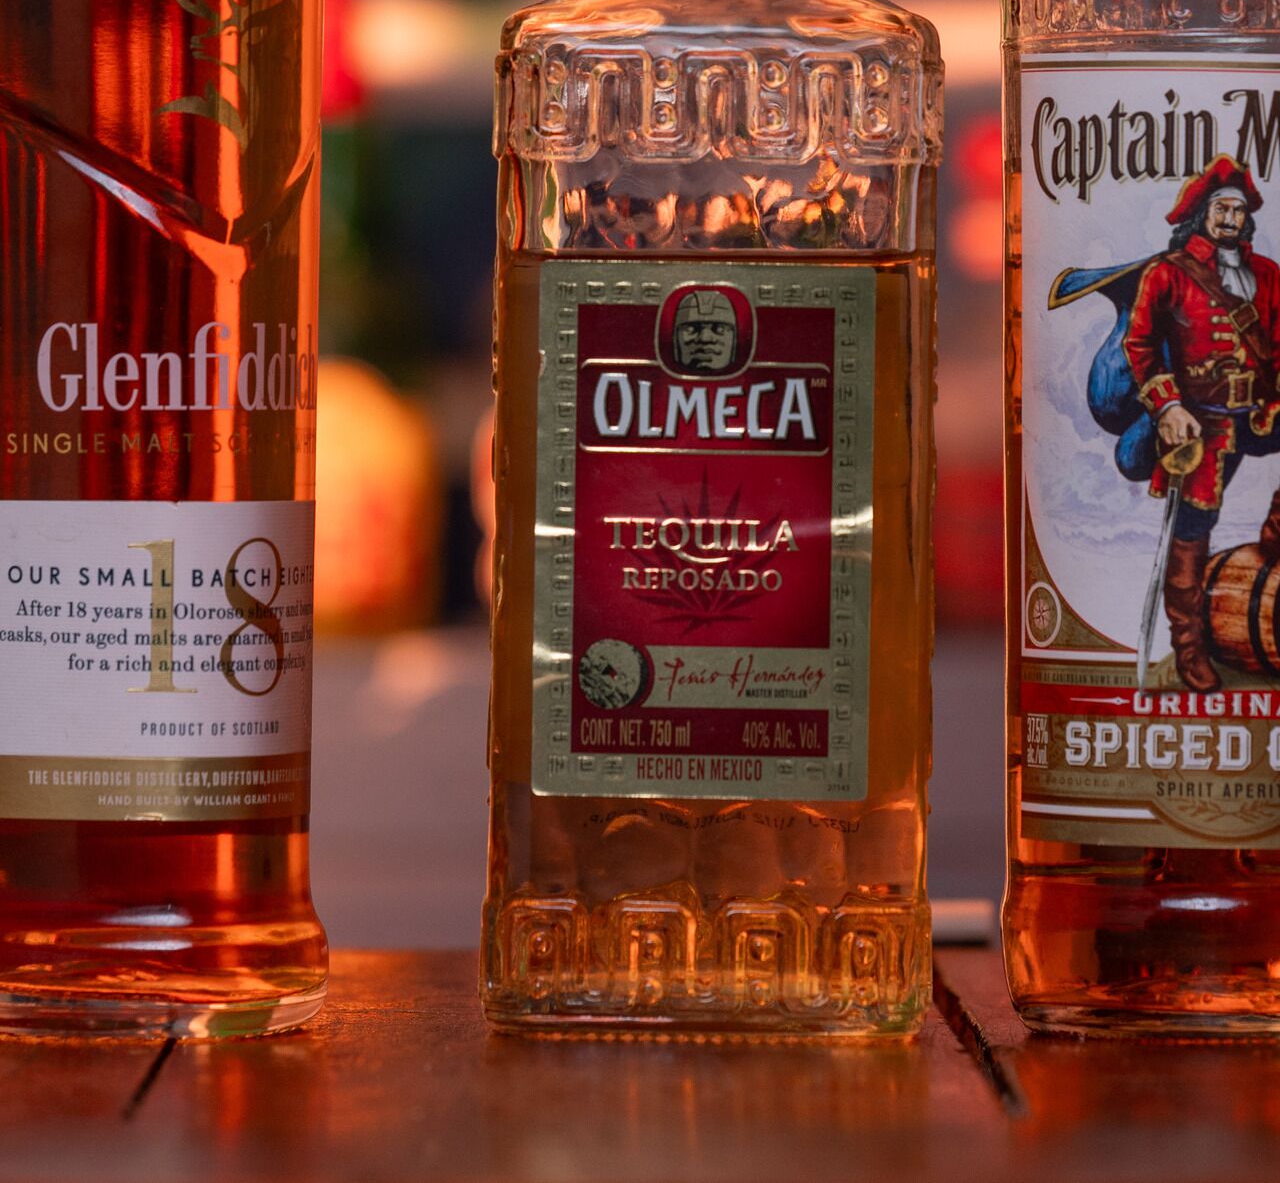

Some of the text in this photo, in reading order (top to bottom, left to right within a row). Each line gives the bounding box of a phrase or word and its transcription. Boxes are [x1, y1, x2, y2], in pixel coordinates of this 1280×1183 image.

[1031, 88, 1217, 204] Captain
[37, 321, 316, 412] Glenfiddich
[593, 372, 817, 440] OLMECA
[6, 433, 106, 454] SINGLE
[121, 434, 193, 454] MALT
[603, 516, 799, 564] TEQUILA
[8, 565, 61, 585] OUR
[79, 567, 172, 587] SMALL
[192, 568, 271, 588] BATCH
[622, 567, 783, 592] REPOSADO
[16, 599, 62, 618] After
[67, 601, 87, 618] 18
[92, 607, 143, 623] years
[149, 603, 167, 620] in
[174, 603, 244, 620] Oloroso
[126, 537, 283, 697] 18
[0, 625, 47, 645] casks,
[50, 631, 81, 644] our
[86, 628, 128, 649] aged
[134, 628, 187, 646] malts
[193, 633, 222, 646] are
[67, 653, 94, 671] for
[99, 658, 110, 671] a
[115, 655, 153, 672] rich
[159, 655, 195, 673] and
[201, 656, 260, 676] elegant
[140, 720, 279, 737] PRODUCT OF SCOTLAND
[580, 718, 691, 747] CONT. NET. 750 ml
[742, 721, 821, 749] 40% Alc. Vol.
[1064, 720, 1252, 772] SPICED
[28, 770, 48, 785] THE
[637, 757, 762, 782] HECHO EN MEXICO
[194, 794, 241, 806] WILLIAM
[1156, 780, 1214, 798] SPIRIT
